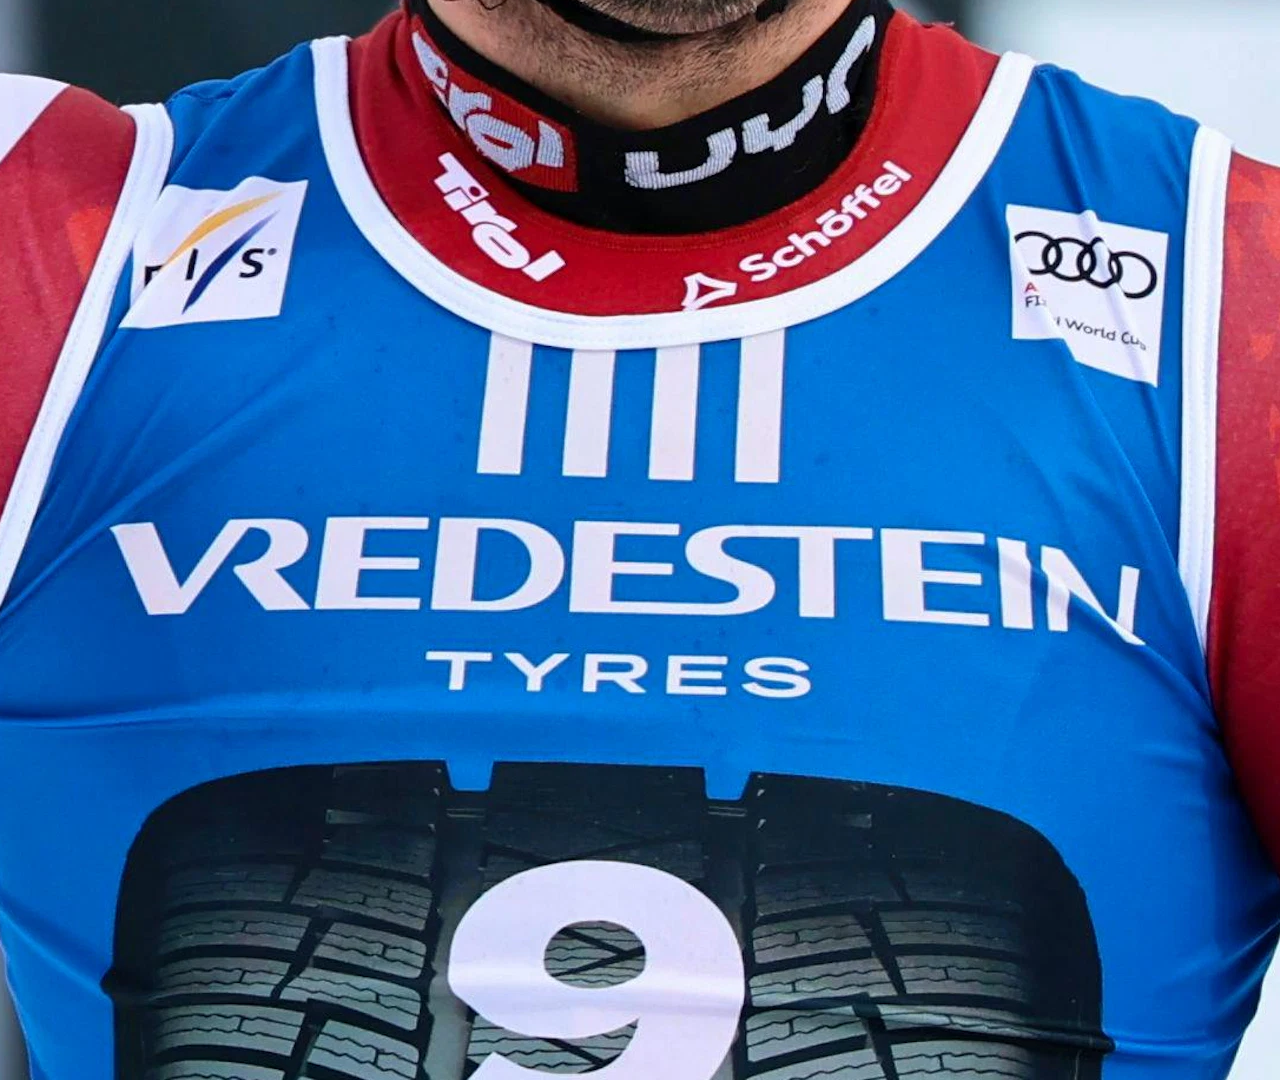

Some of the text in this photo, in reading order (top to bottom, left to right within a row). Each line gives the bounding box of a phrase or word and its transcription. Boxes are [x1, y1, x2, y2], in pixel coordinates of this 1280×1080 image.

[434, 152, 566, 282] Tirol
[1064, 318, 1117, 341] World
[112, 516, 1147, 646] VREDESTEIN
[425, 651, 813, 699] TYRES
[447, 859, 745, 1080] 9
